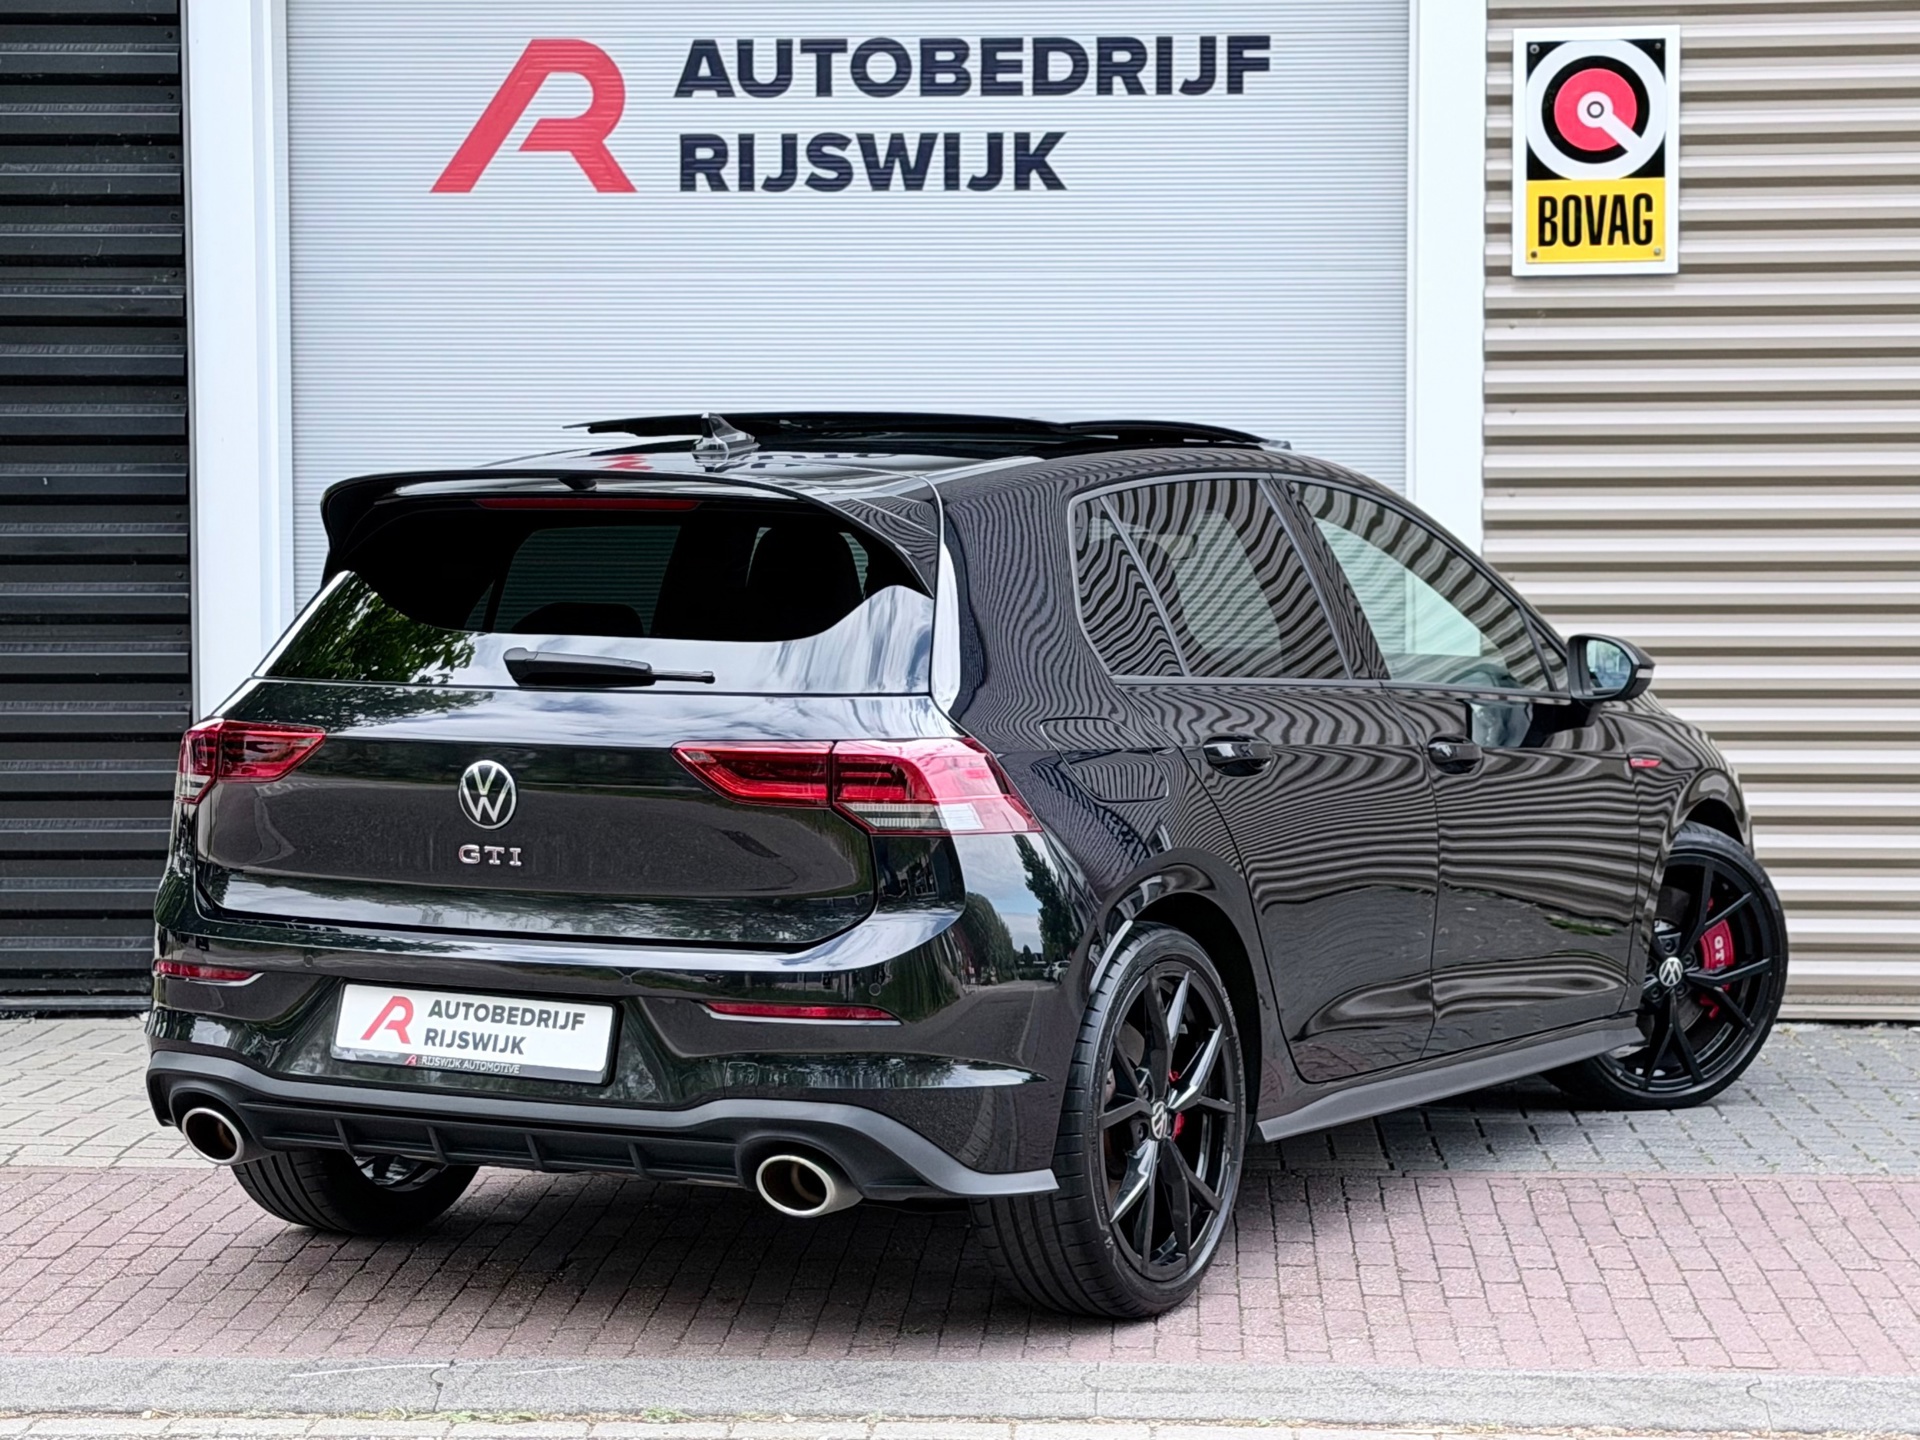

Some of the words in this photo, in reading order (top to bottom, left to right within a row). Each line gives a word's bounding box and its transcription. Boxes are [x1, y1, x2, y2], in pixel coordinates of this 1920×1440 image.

[674, 35, 1271, 98] AUTOBEDRIJF
[680, 132, 1068, 193] RIJSWIJK
[1538, 193, 1654, 247] BOVAG
[459, 844, 522, 867] GTI
[428, 999, 586, 1031] AUTOBEDRIJF
[424, 1027, 526, 1055] RIJSWIJK
[421, 1055, 462, 1068] RIJSWIJK
[462, 1060, 521, 1074] AUTOMOTIVE
